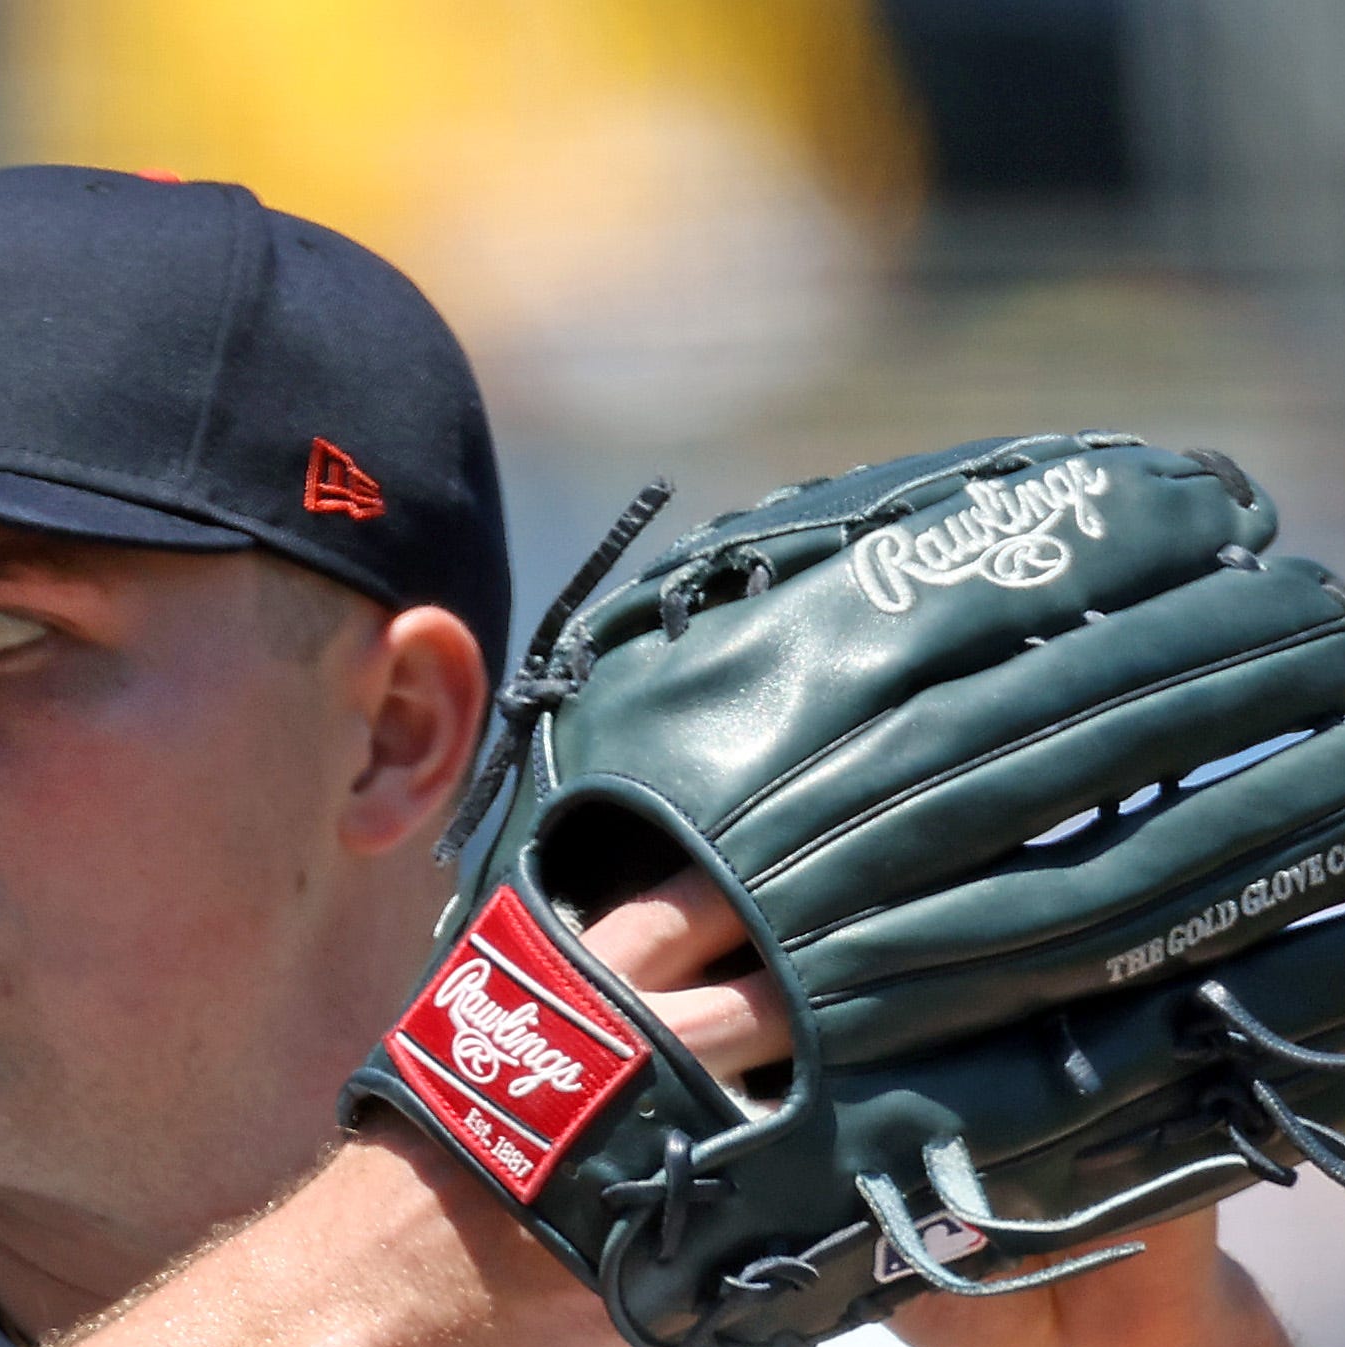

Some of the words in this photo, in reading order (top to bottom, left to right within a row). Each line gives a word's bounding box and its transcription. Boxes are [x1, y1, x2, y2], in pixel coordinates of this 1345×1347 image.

[846, 456, 1109, 614] Rawlings
[1106, 936, 1165, 984] THE
[1166, 900, 1239, 956] GOLD
[1241, 853, 1327, 917] GLOVE
[434, 957, 584, 1098] Rawlings
[490, 1135, 534, 1178] 1887
